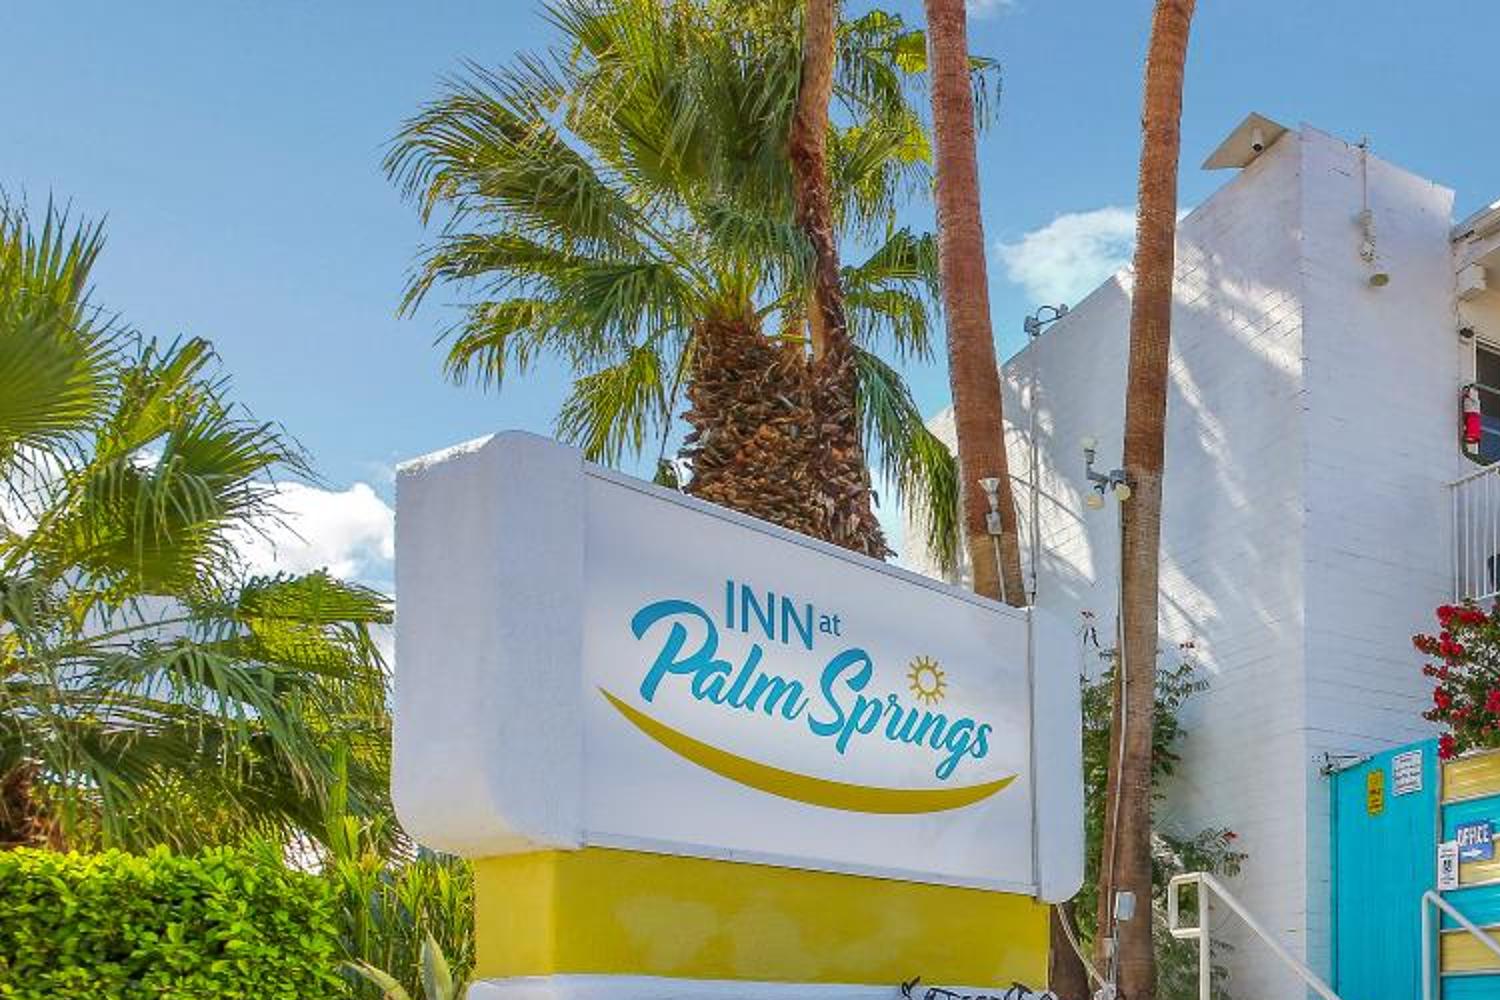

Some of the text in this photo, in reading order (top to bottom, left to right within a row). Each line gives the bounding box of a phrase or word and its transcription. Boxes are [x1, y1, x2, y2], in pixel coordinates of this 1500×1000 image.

[725, 580, 841, 651] INN at
[631, 598, 993, 780] Palm Springs
[1457, 823, 1489, 847] OFFICE
